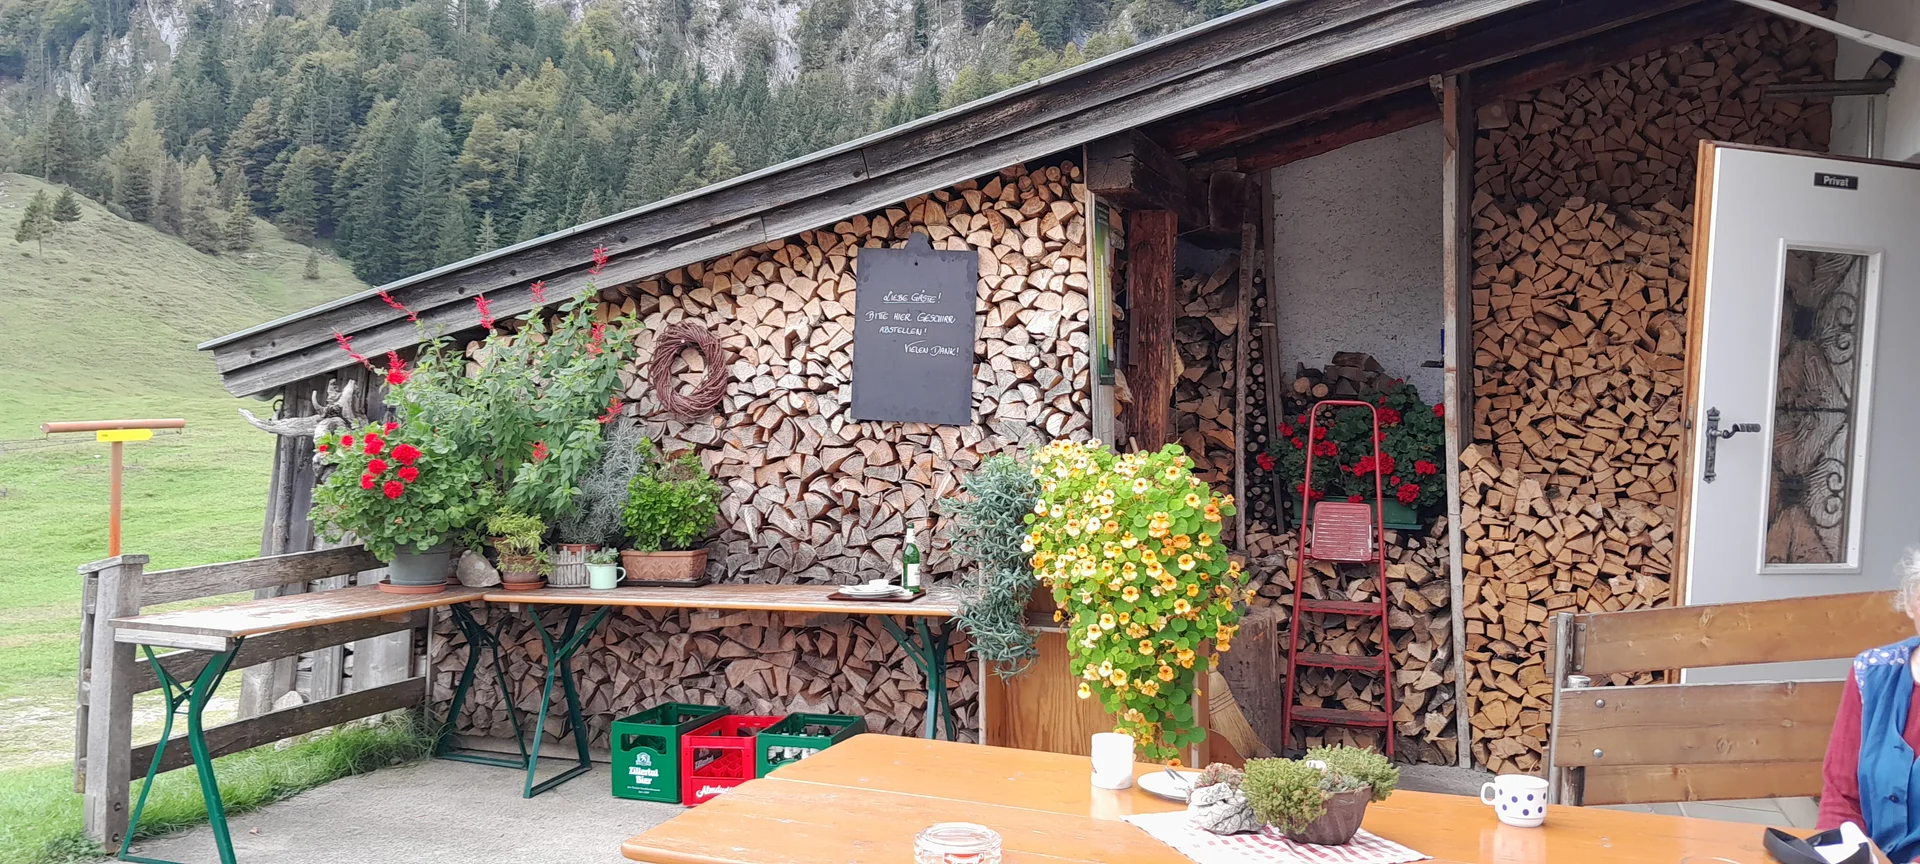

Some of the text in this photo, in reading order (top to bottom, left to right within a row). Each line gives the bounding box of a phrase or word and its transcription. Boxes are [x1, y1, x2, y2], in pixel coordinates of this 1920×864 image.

[1823, 175, 1849, 187] Privat
[883, 291, 908, 302] LIEBE
[893, 312, 912, 321] HIER
[917, 312, 956, 323] GESCHIRR
[879, 326, 927, 336] ABSTELLEN!
[904, 340, 960, 356] VIELEN DANK!
[628, 766, 659, 777] Zillertal
[635, 775, 652, 785] Bier
